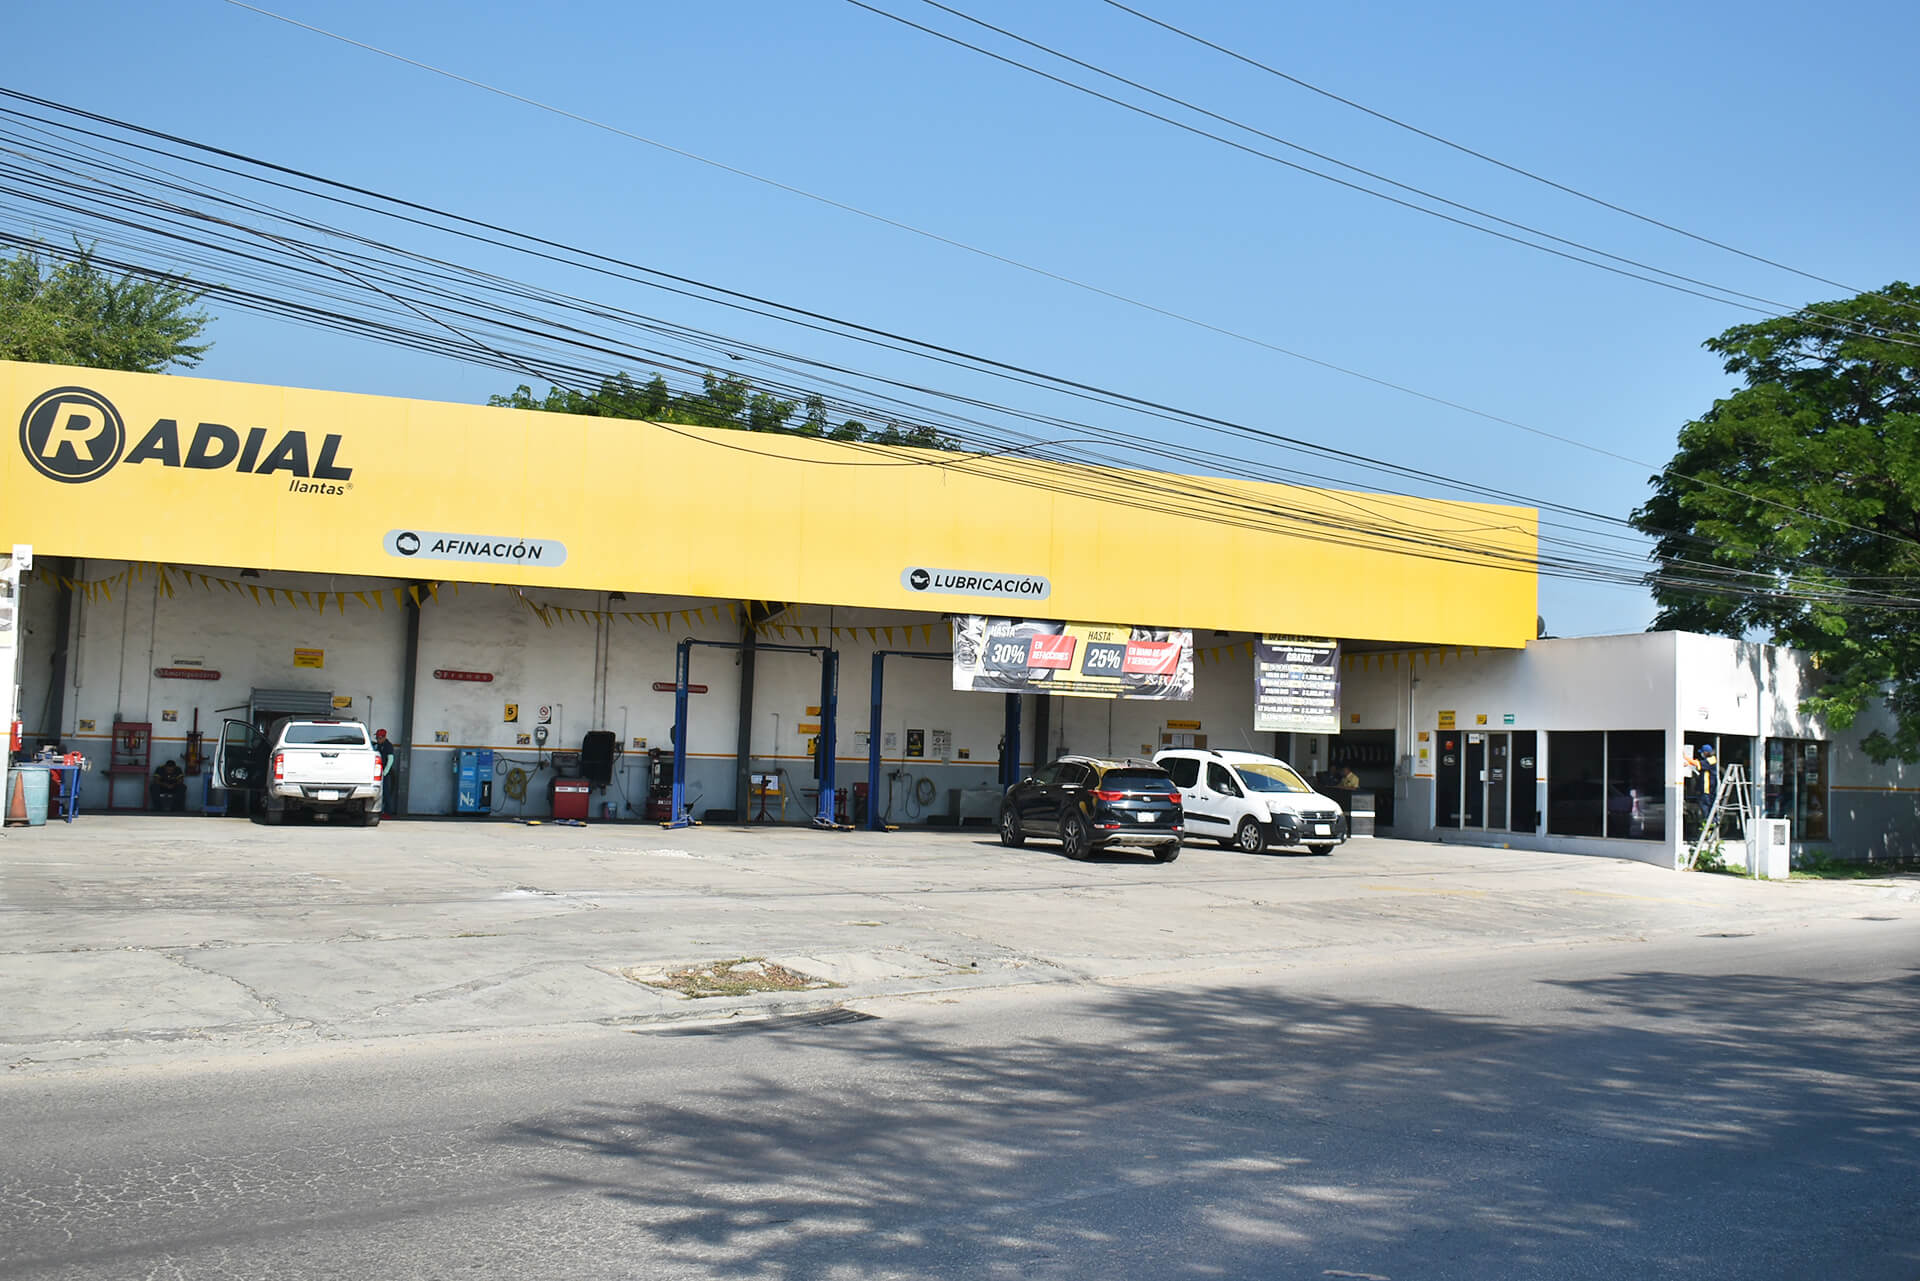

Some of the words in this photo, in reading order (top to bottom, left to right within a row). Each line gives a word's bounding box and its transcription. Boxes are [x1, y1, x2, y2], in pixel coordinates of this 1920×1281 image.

[20, 387, 353, 483] RADIAL
[431, 540, 543, 561] AFINACIÓN
[933, 574, 1044, 595] LUBRICACIÓN
[991, 643, 1025, 664] 30%
[1087, 648, 1121, 669] 25%
[507, 707, 514, 715] 5
[459, 791, 475, 808] N2
